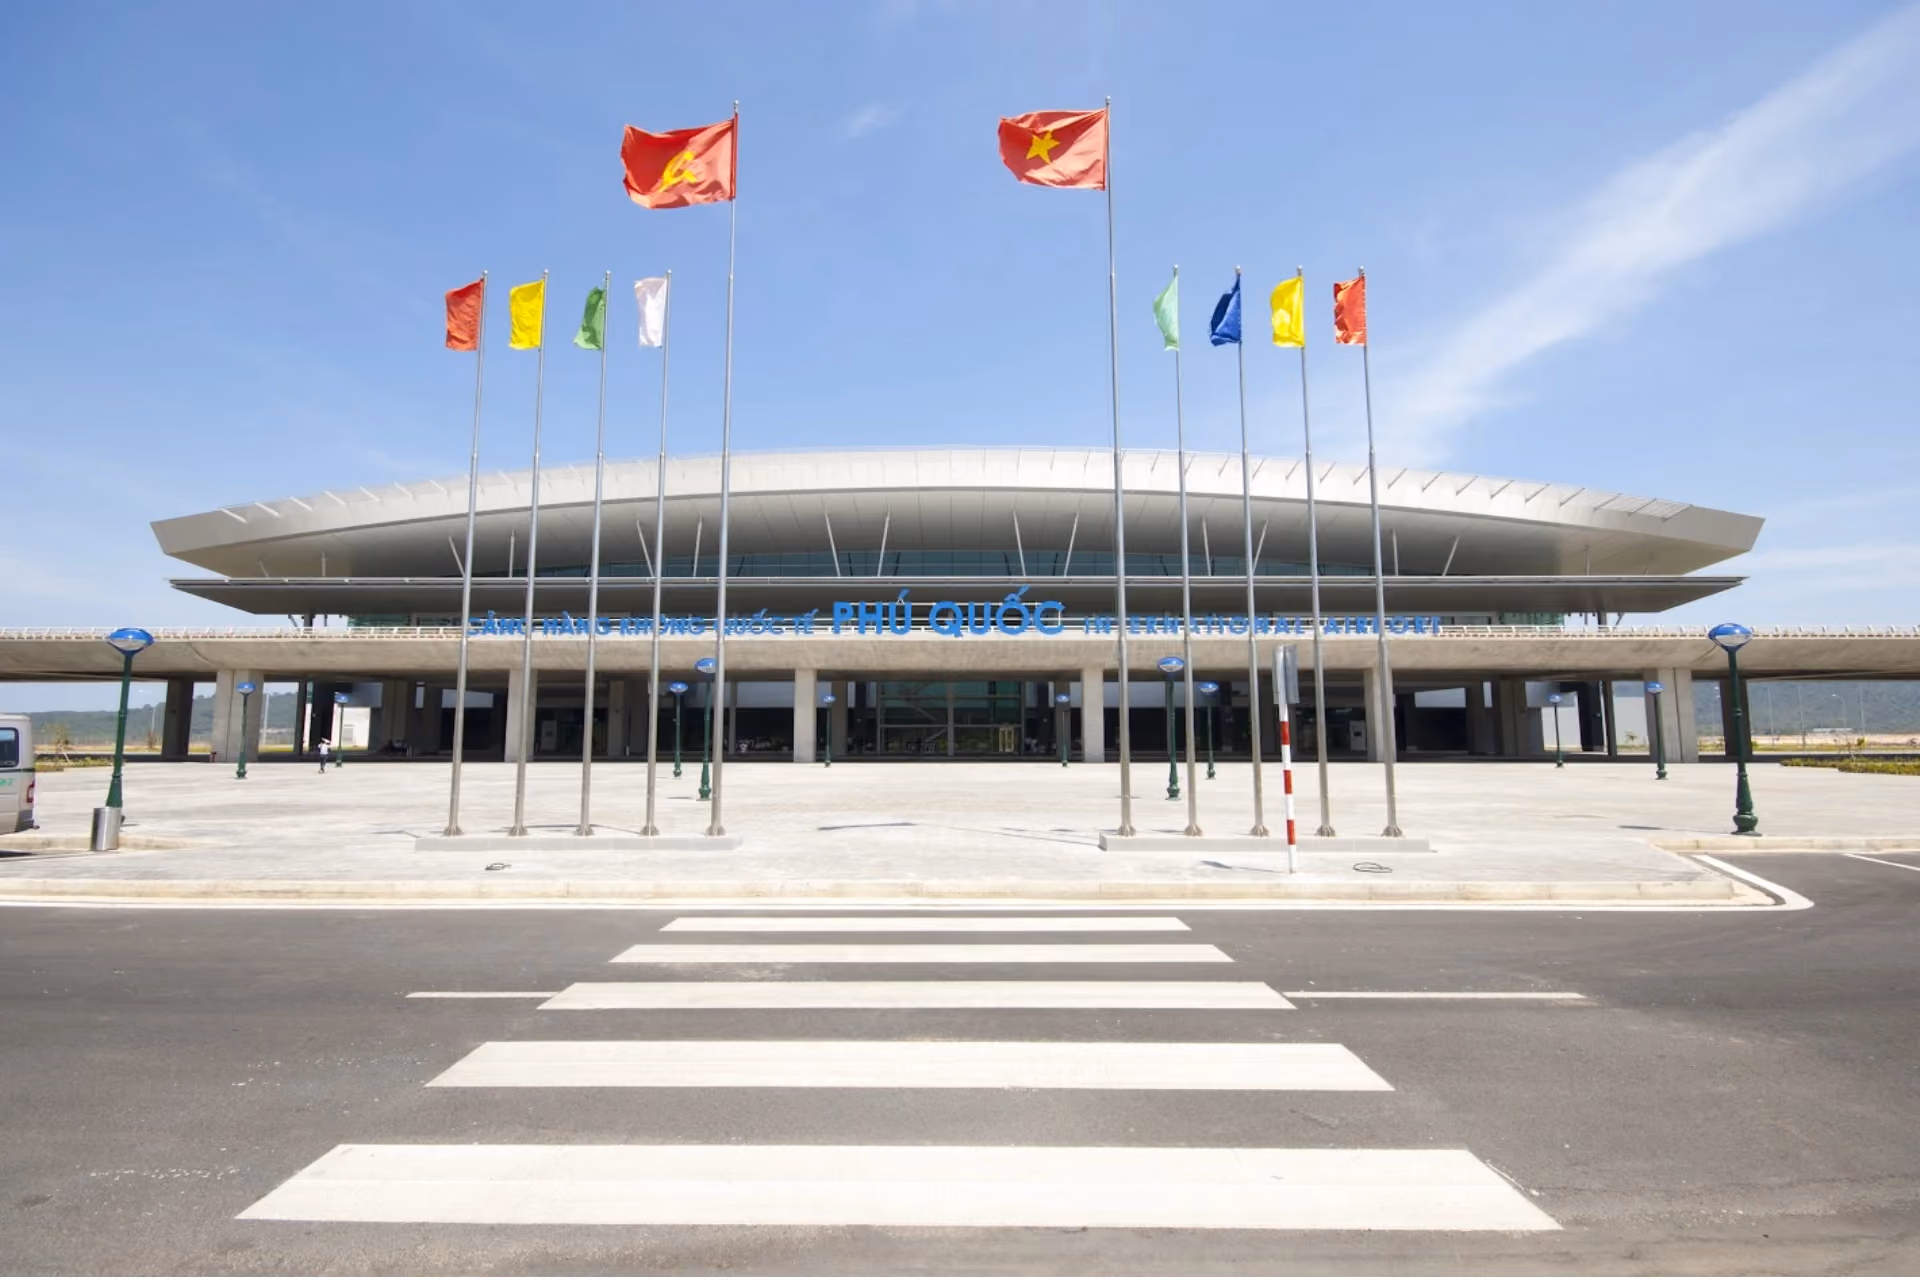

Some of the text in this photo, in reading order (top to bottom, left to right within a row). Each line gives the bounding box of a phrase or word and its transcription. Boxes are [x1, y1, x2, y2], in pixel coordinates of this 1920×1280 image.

[793, 608, 819, 635] TẾ
[832, 588, 912, 635] PHÚ
[928, 584, 1067, 637] QUỐC
[1083, 615, 1304, 634] INERNATIONAL
